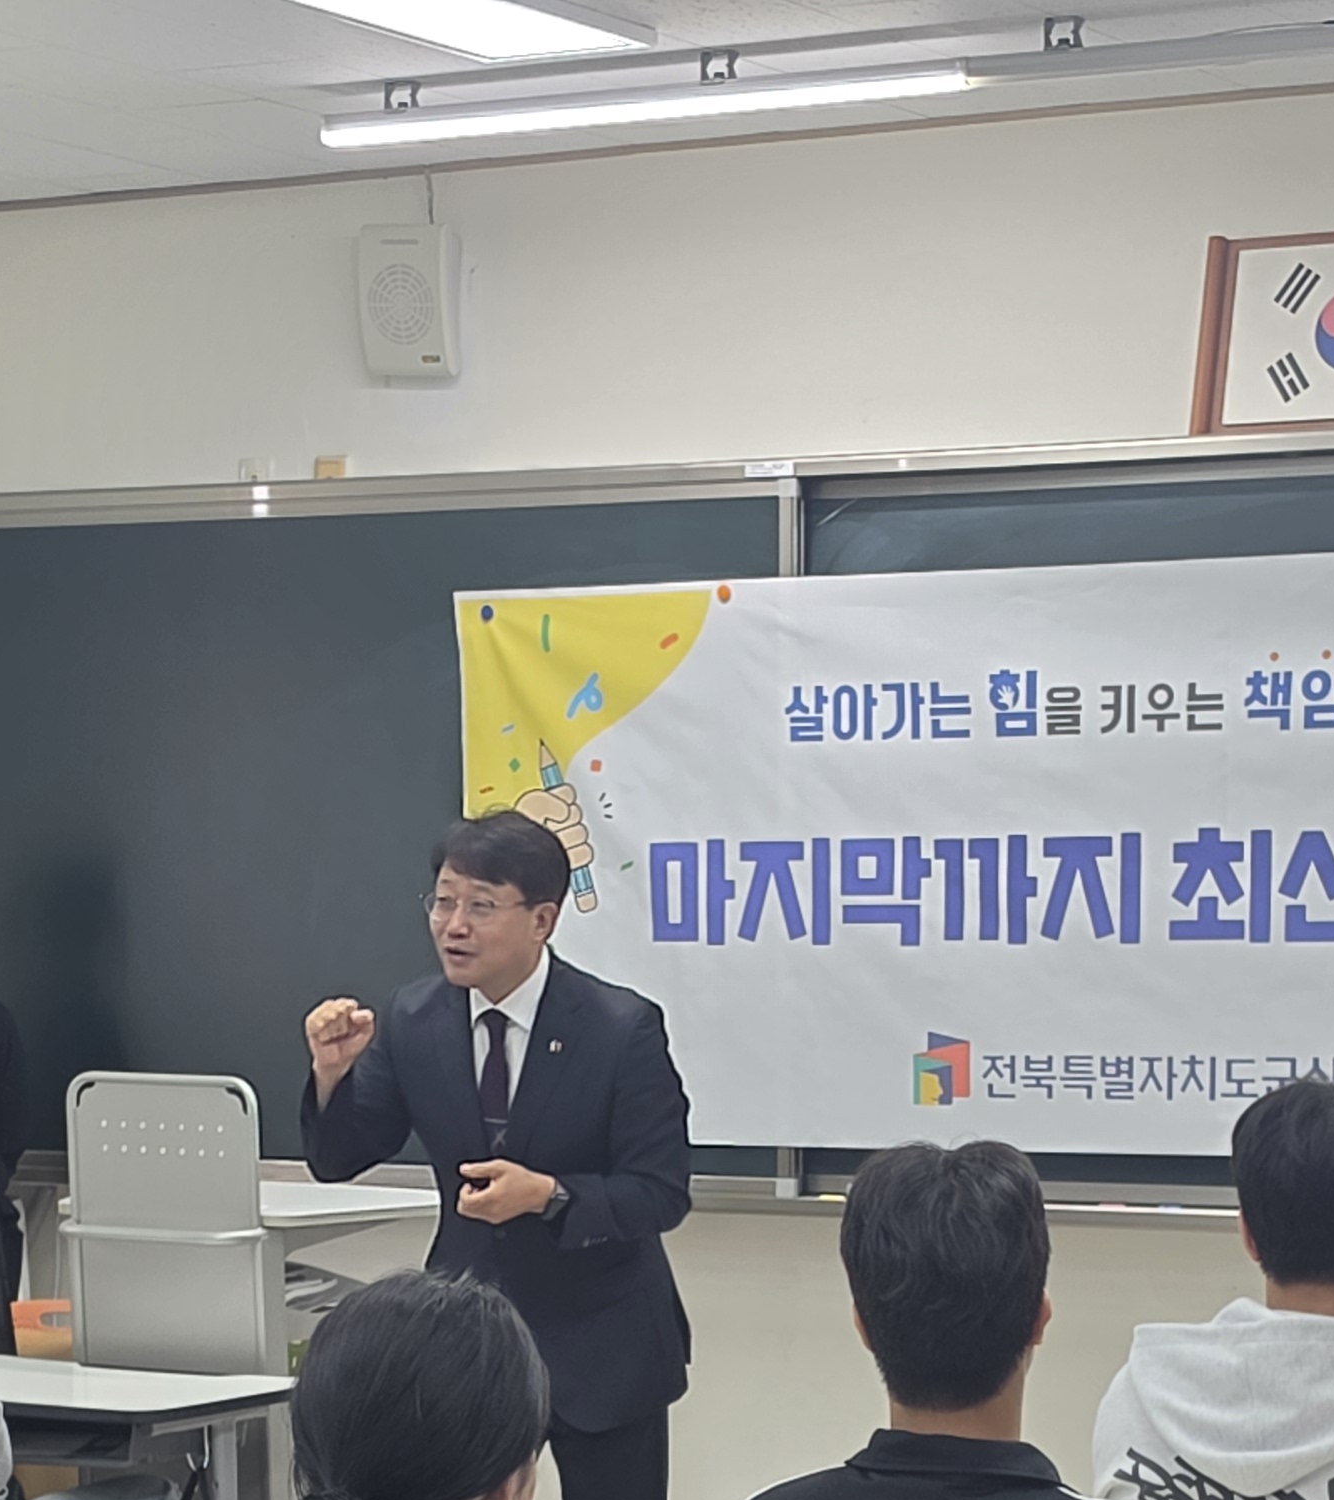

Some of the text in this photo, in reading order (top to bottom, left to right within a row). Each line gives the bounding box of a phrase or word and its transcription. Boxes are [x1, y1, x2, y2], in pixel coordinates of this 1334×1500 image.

[784, 680, 972, 743] 살아가는
[988, 669, 1083, 738] 힘을
[1098, 681, 1225, 735] 키우는
[648, 831, 1142, 947] 마지막까지
